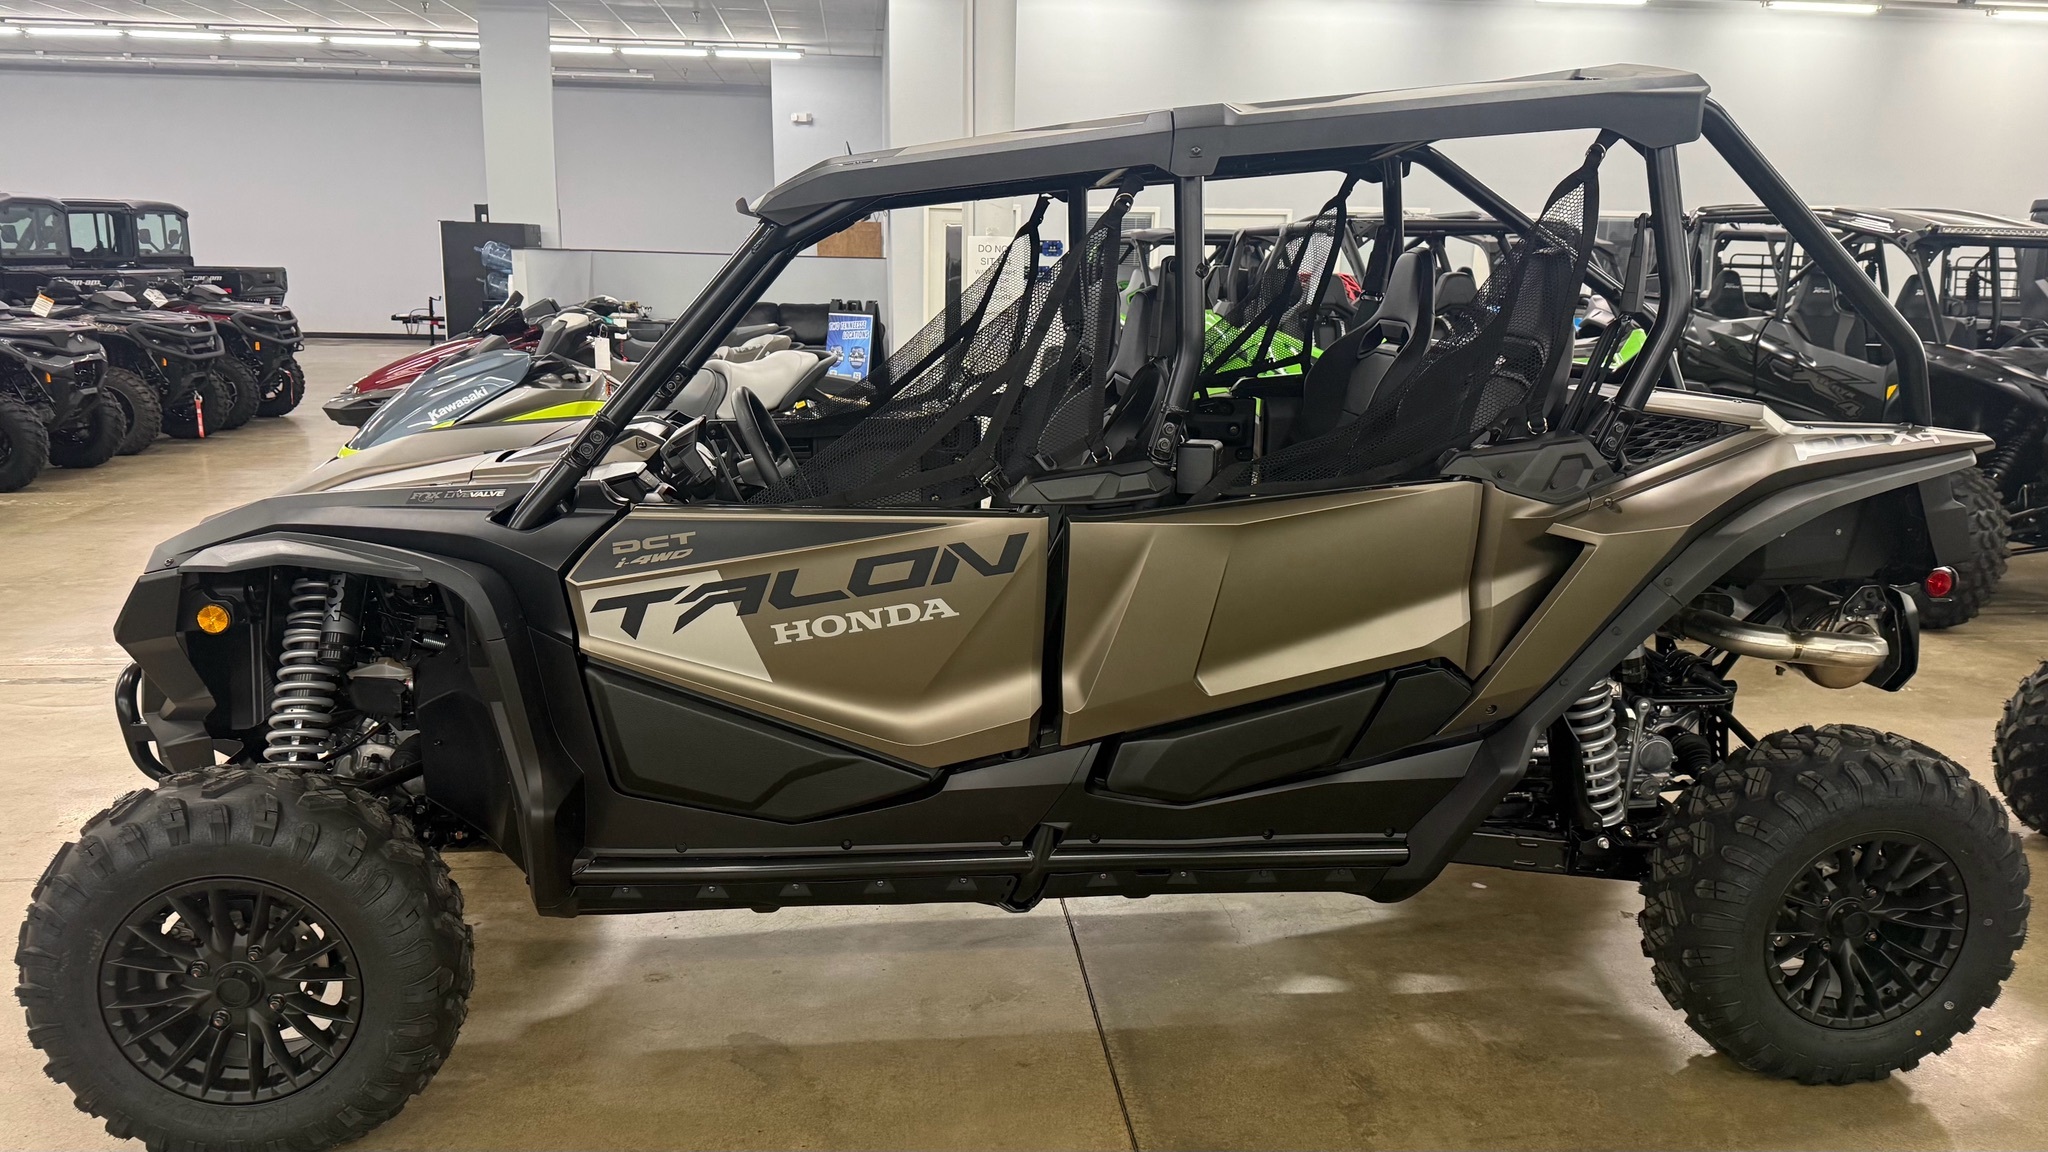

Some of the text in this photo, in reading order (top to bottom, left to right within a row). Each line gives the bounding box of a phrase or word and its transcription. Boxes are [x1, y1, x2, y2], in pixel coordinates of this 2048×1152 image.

[977, 244, 1010, 253] DO NO
[428, 386, 488, 423] Kawasaki
[410, 491, 443, 502] FOX
[612, 531, 696, 555] DCT
[614, 548, 694, 569] i-4WD
[323, 572, 347, 621] FOX
[590, 532, 1029, 640] TALON
[770, 598, 960, 645] HONDA
